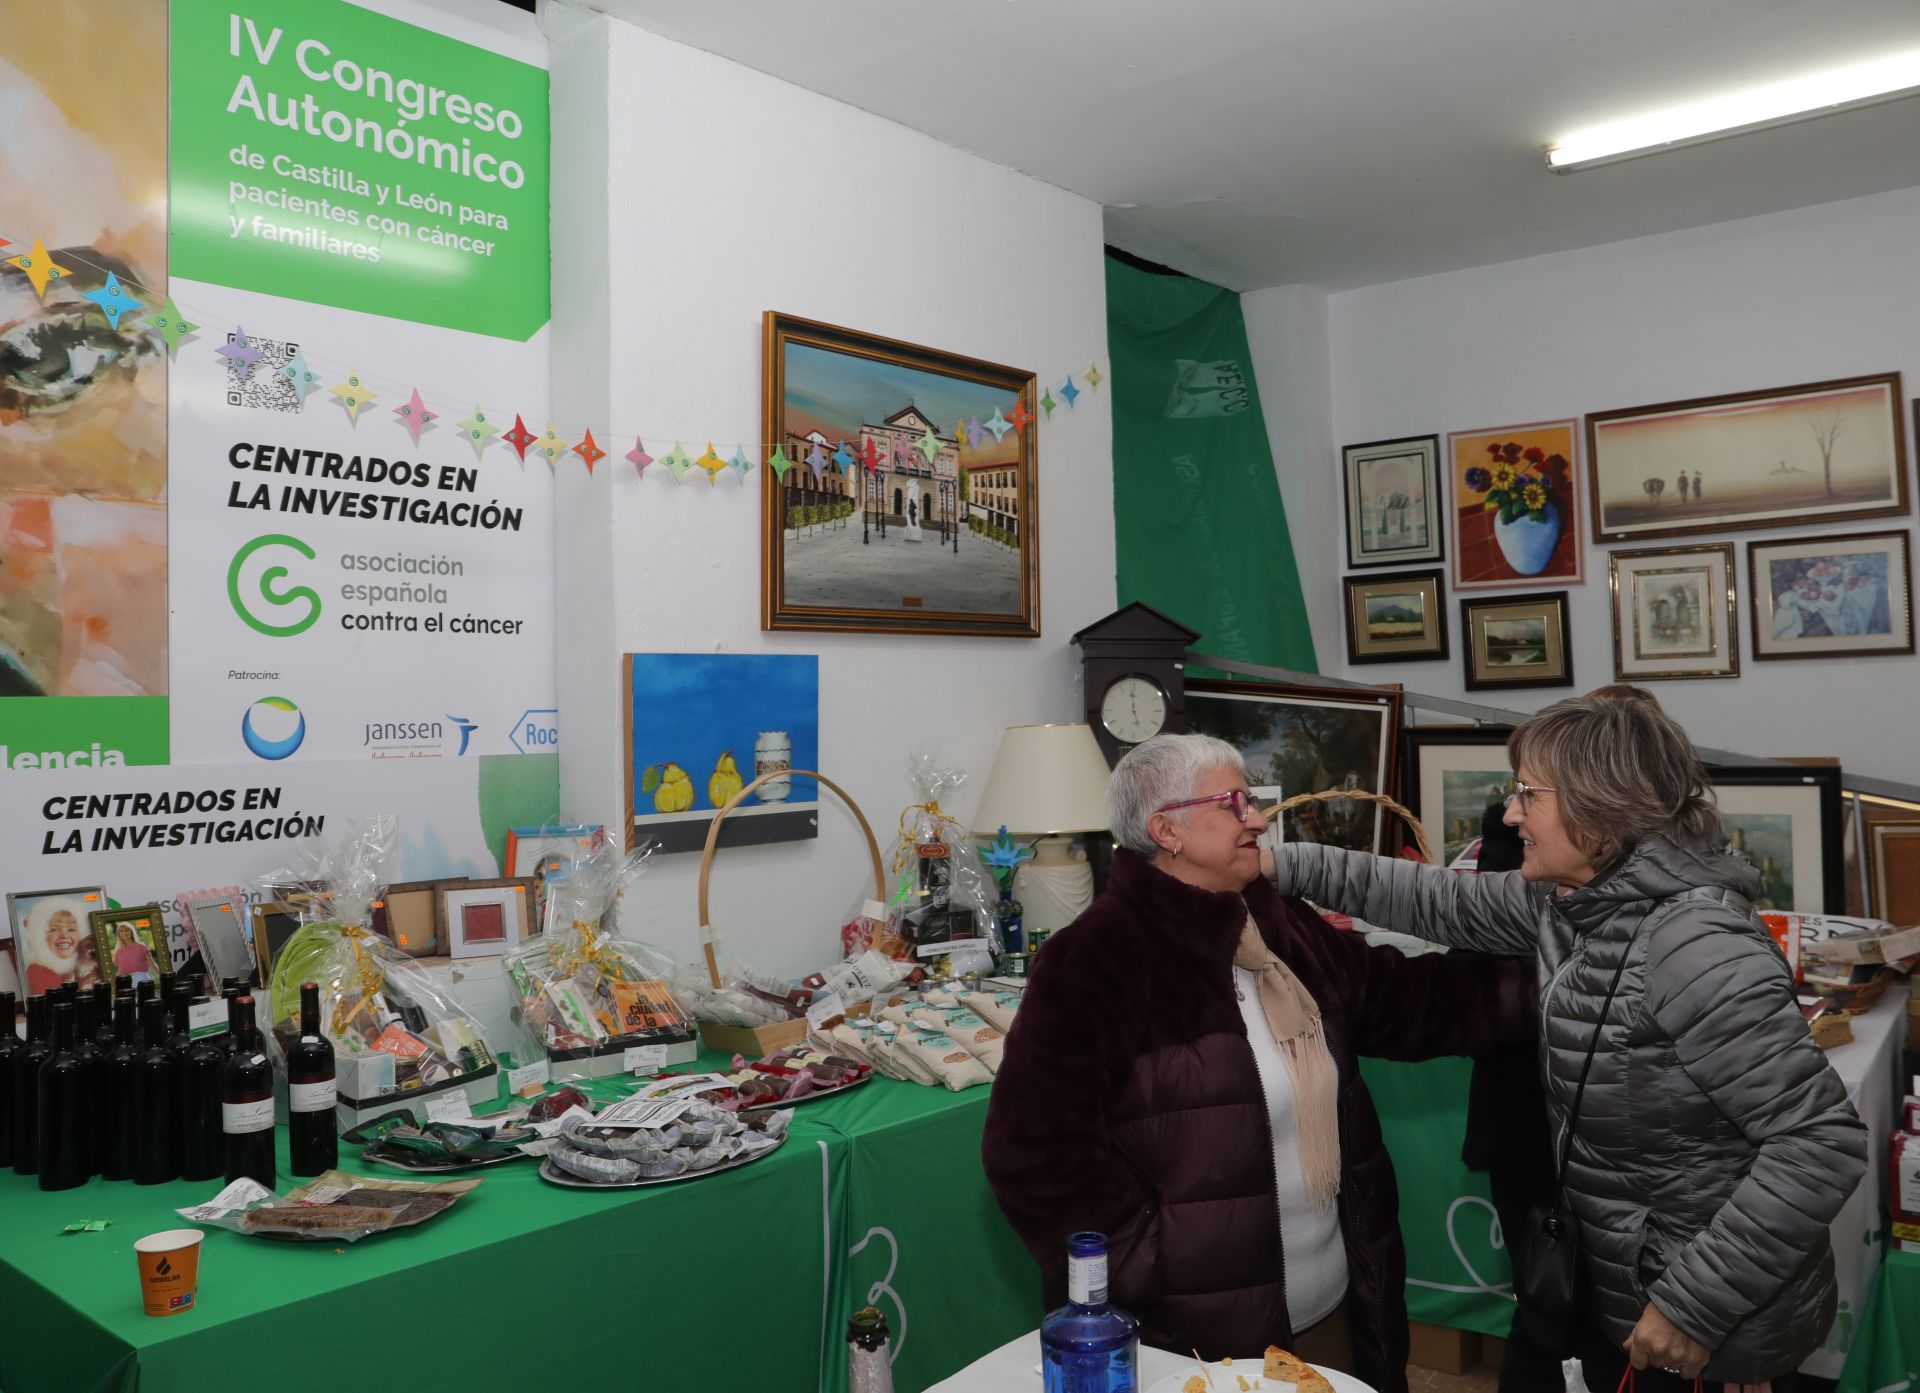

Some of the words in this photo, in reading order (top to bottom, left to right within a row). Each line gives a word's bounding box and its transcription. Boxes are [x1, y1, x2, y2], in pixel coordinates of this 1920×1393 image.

[229, 13, 283, 66] IV
[295, 39, 523, 140] Congreso
[226, 74, 525, 189] Autonómico
[229, 144, 266, 171] de
[272, 154, 370, 197] Castilla
[375, 183, 390, 206] y
[396, 184, 453, 217] León
[459, 205, 509, 231] para
[229, 180, 360, 226] pacientes
[366, 213, 411, 239] con
[416, 224, 495, 256] cáncer
[229, 214, 246, 239] y
[252, 215, 381, 263] familiares
[227, 442, 431, 488] CENTRADOS
[437, 465, 478, 493] EN
[227, 481, 271, 511] LA
[280, 485, 523, 532] INVESTIGACIÓN
[340, 552, 464, 577] asociación
[340, 582, 448, 607] española
[340, 612, 418, 632] contra
[424, 612, 443, 633] el
[449, 612, 523, 635] cáncer
[42, 789, 237, 821] CENTRADOS
[242, 787, 281, 810] EN
[42, 829, 83, 855] LA
[90, 811, 325, 852] INVESTIGACIÓN
